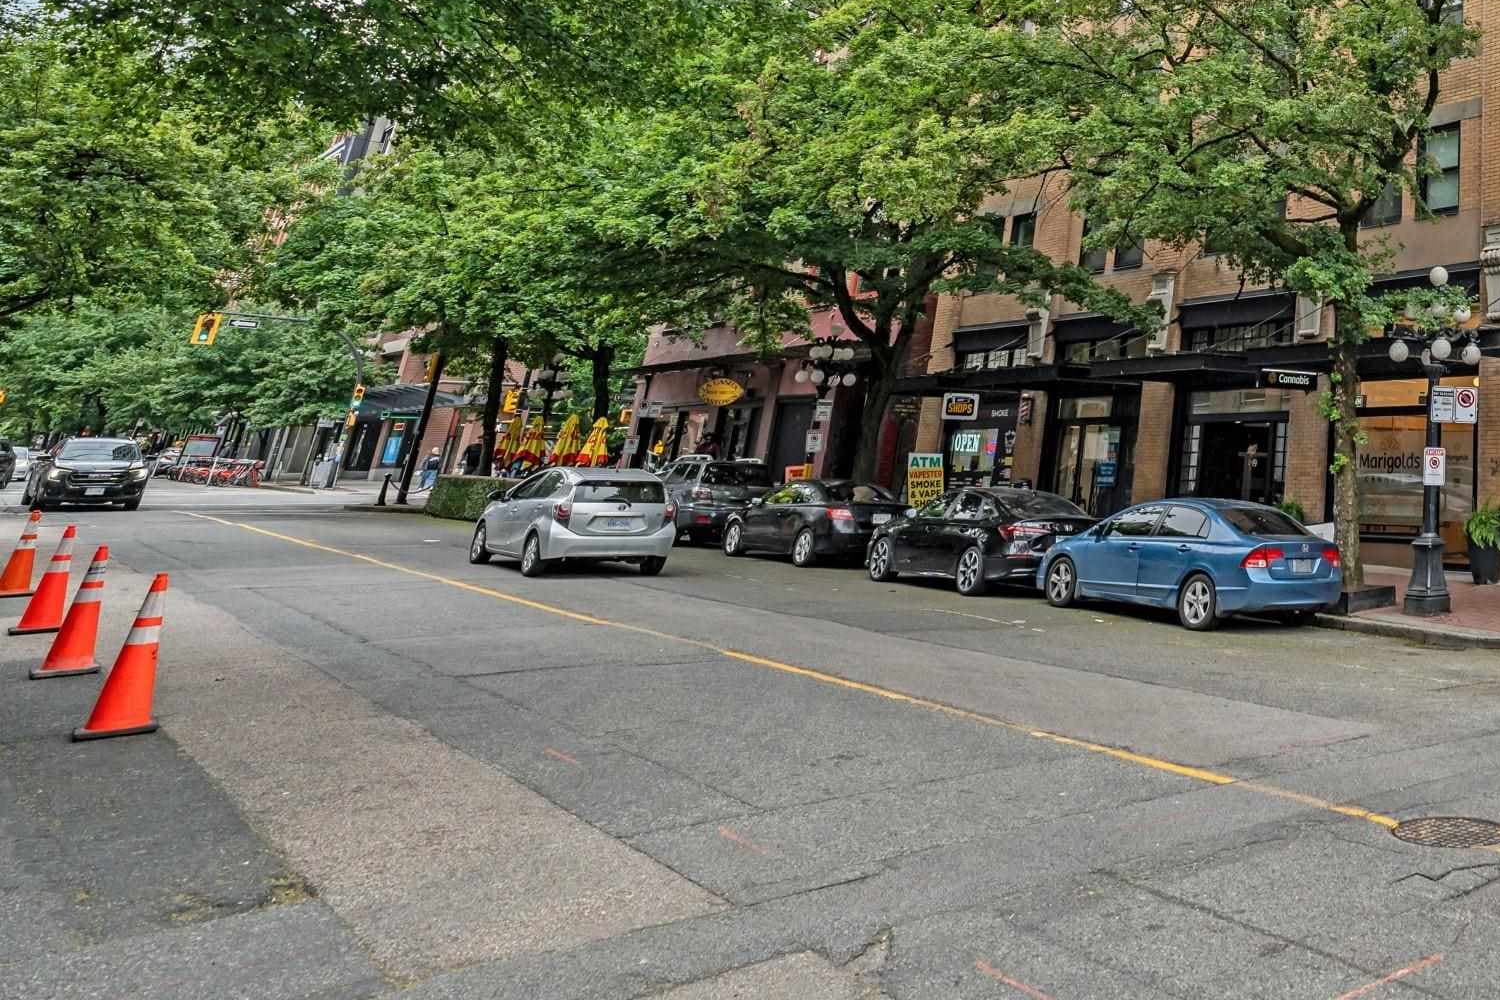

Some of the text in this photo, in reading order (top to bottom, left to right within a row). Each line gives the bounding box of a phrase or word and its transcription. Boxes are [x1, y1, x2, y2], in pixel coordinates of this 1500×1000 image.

[1278, 373, 1310, 385] Cannabis
[947, 402, 974, 415] SHOPS
[954, 433, 981, 452] OPEN
[911, 456, 941, 467] ATM
[1360, 452, 1421, 473] Marigolds
[910, 480, 942, 489] SMOKE
[910, 488, 943, 499] & VAPE
